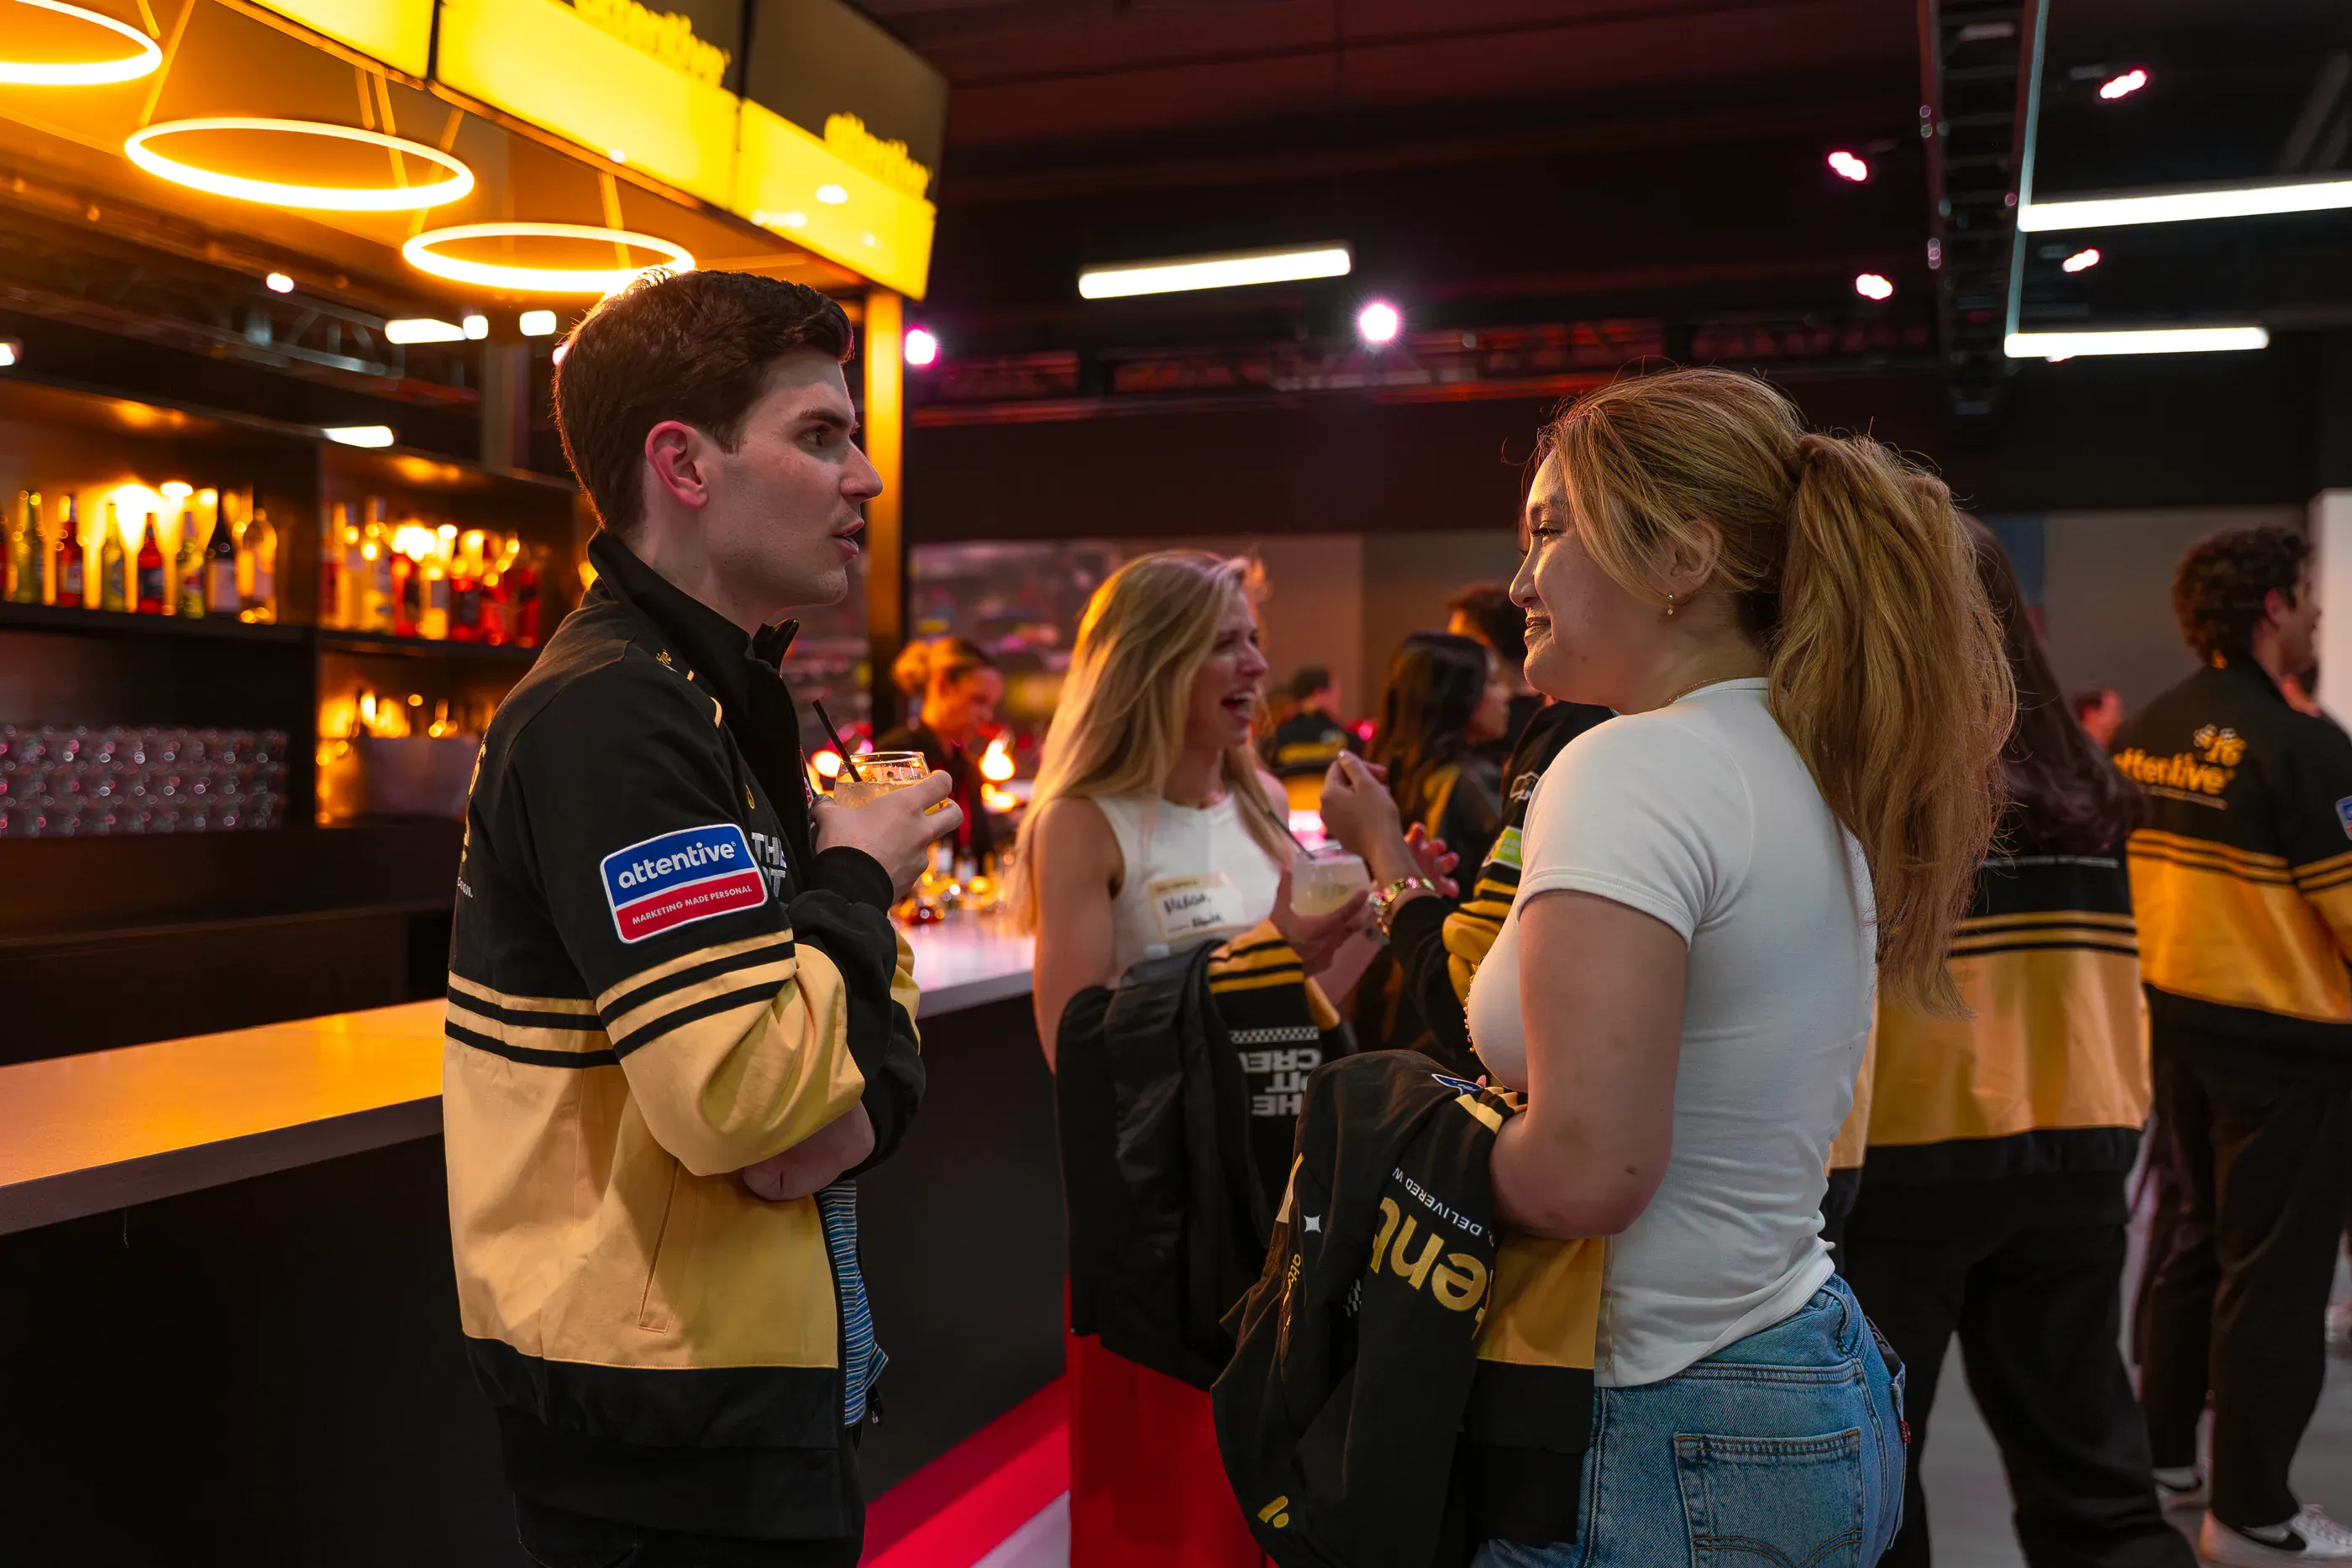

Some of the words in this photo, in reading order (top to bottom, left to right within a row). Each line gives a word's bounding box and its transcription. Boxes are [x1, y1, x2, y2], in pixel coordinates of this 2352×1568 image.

[619, 842, 735, 889] attentive
[632, 901, 683, 925] MARKETING
[685, 894, 709, 907] MADE
[710, 885, 753, 900] PERSONAL
[1251, 1093, 1304, 1116] HE
[1405, 1178, 1483, 1236] DELIVERED
